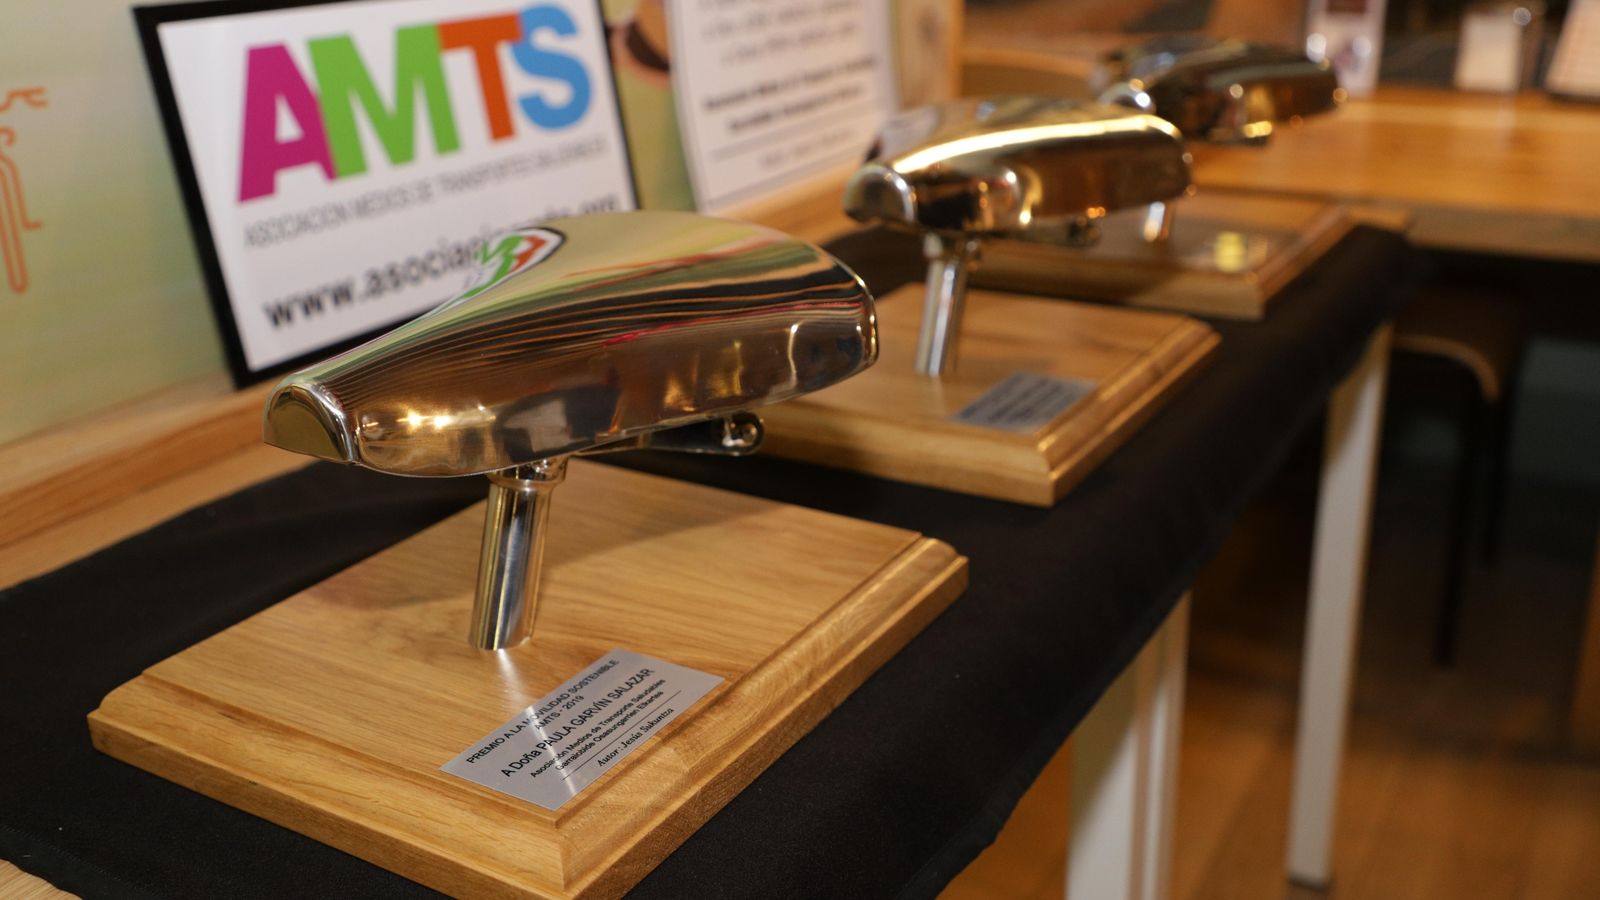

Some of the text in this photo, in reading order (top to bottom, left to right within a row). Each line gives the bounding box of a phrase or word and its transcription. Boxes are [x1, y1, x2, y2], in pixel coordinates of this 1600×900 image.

[238, 2, 592, 203] AMTS
[568, 660, 619, 694] SOSTENIBLE
[500, 669, 654, 777] A Doña PAULA GARVÍN SALAZAR
[509, 723, 525, 734] LA
[534, 712, 560, 730] AMTS
[562, 696, 584, 710] 2019
[466, 738, 506, 764] PREMIO
[504, 731, 515, 739] A
[530, 750, 569, 778] Asociación
[565, 733, 593, 751] Medios
[598, 703, 634, 726] Transporte
[621, 732, 644, 748] Jesús
